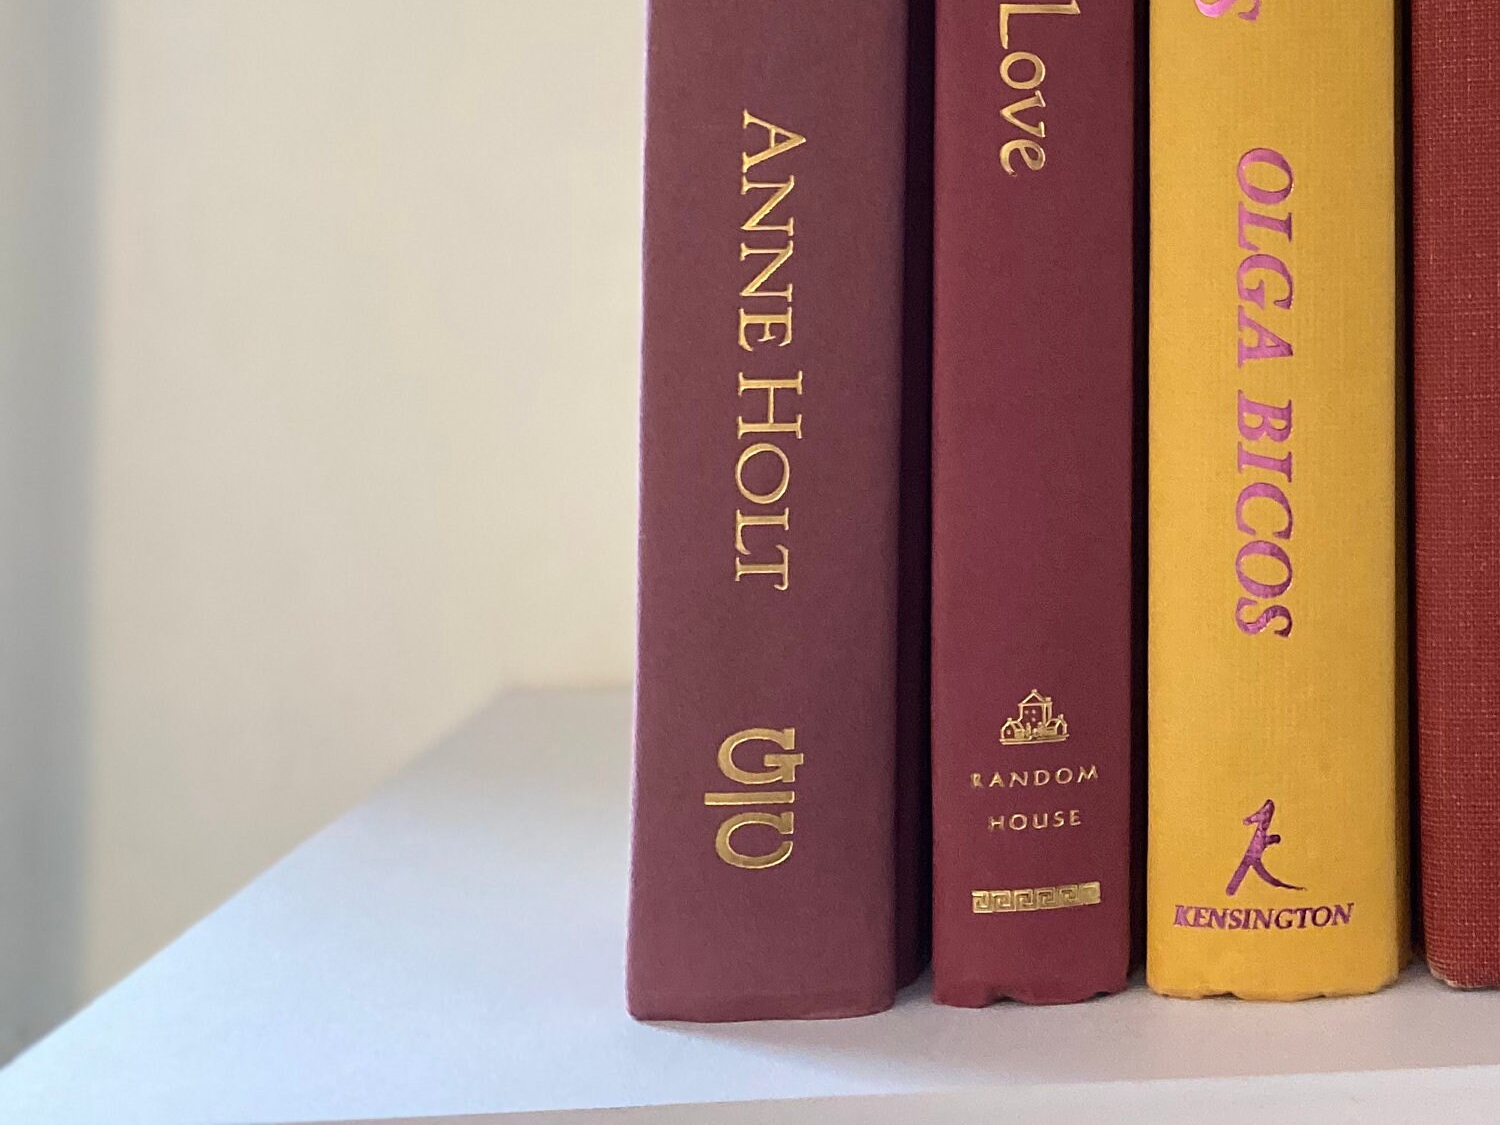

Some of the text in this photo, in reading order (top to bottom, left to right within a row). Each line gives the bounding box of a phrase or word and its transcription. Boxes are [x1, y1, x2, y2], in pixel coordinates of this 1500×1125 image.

[999, 0, 1081, 177] Love
[735, 110, 806, 591] ANNE HOLT
[1235, 147, 1294, 638] OLGA BICOS
[971, 765, 1098, 787] RANDOM
[989, 810, 1081, 831] HOUSE
[1174, 902, 1355, 930] KENSINGTON
